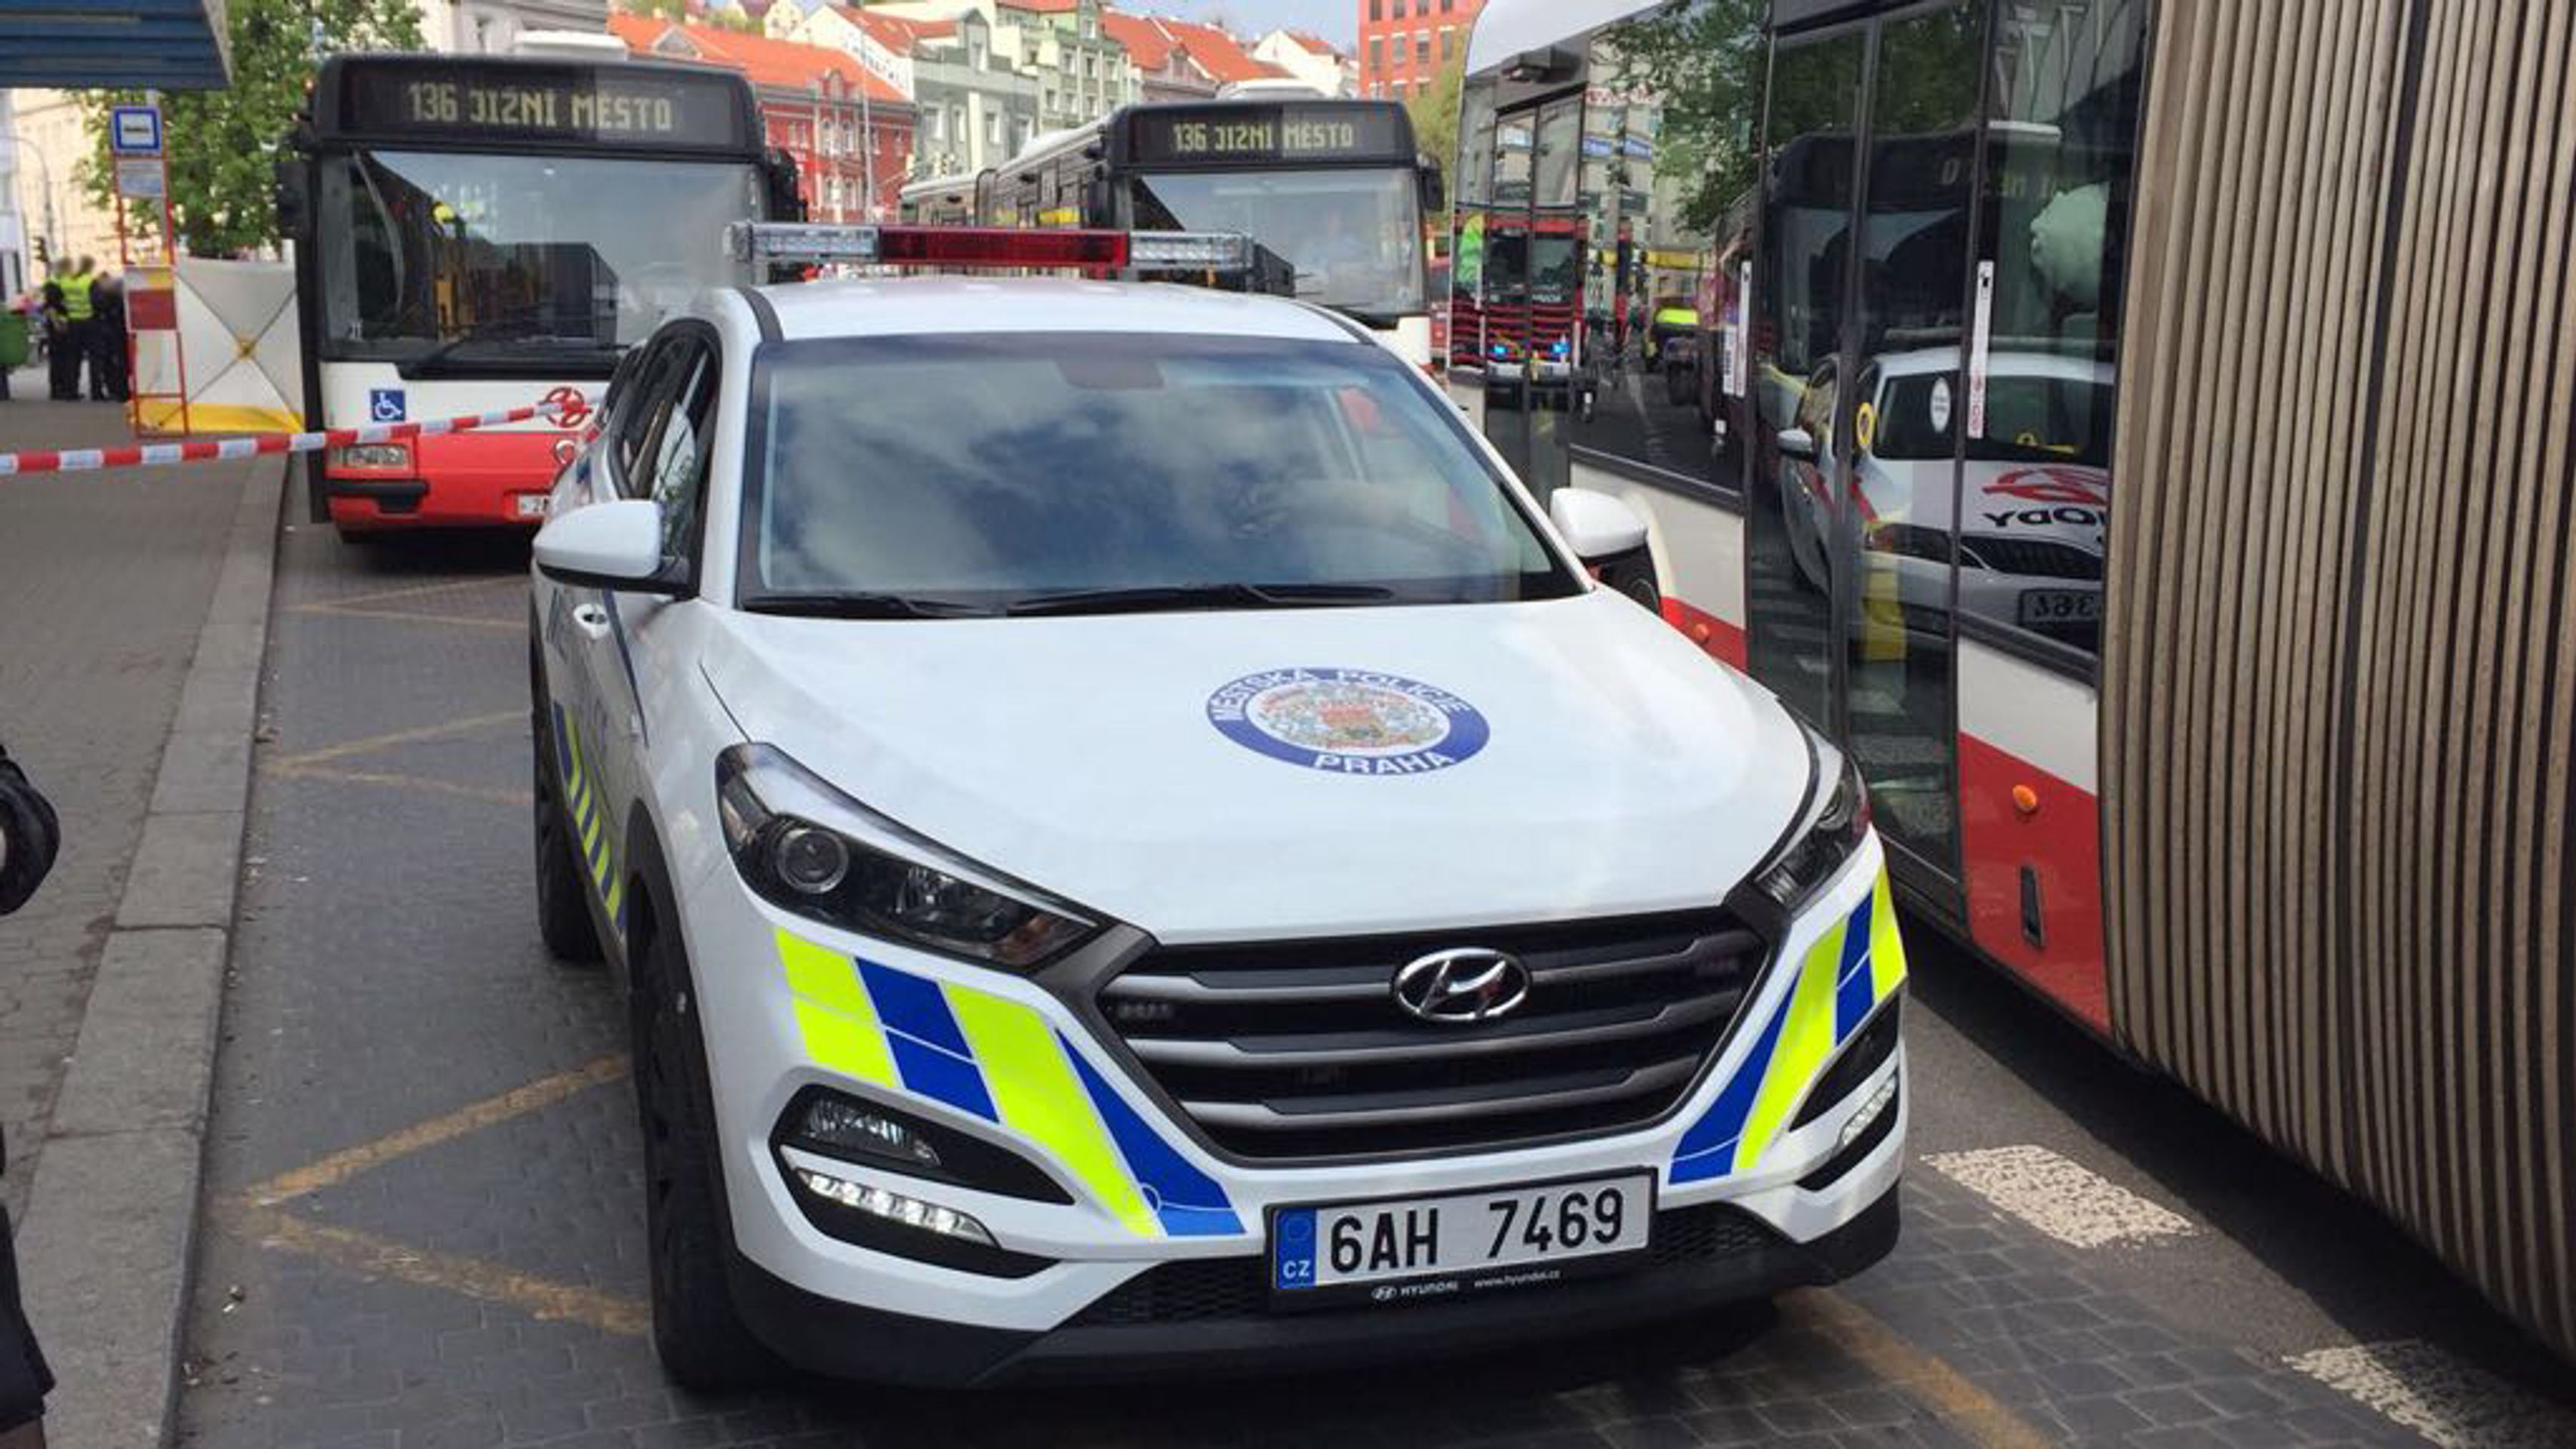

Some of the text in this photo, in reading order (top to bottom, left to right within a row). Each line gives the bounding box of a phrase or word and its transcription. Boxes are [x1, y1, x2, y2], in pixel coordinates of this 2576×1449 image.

[408, 82, 458, 122] 136
[1172, 122, 1208, 152] 136
[1313, 752, 1456, 774] PRAHA
[1329, 1187, 1624, 1275] 6AH 7469
[1282, 1260, 1310, 1278] CZ
